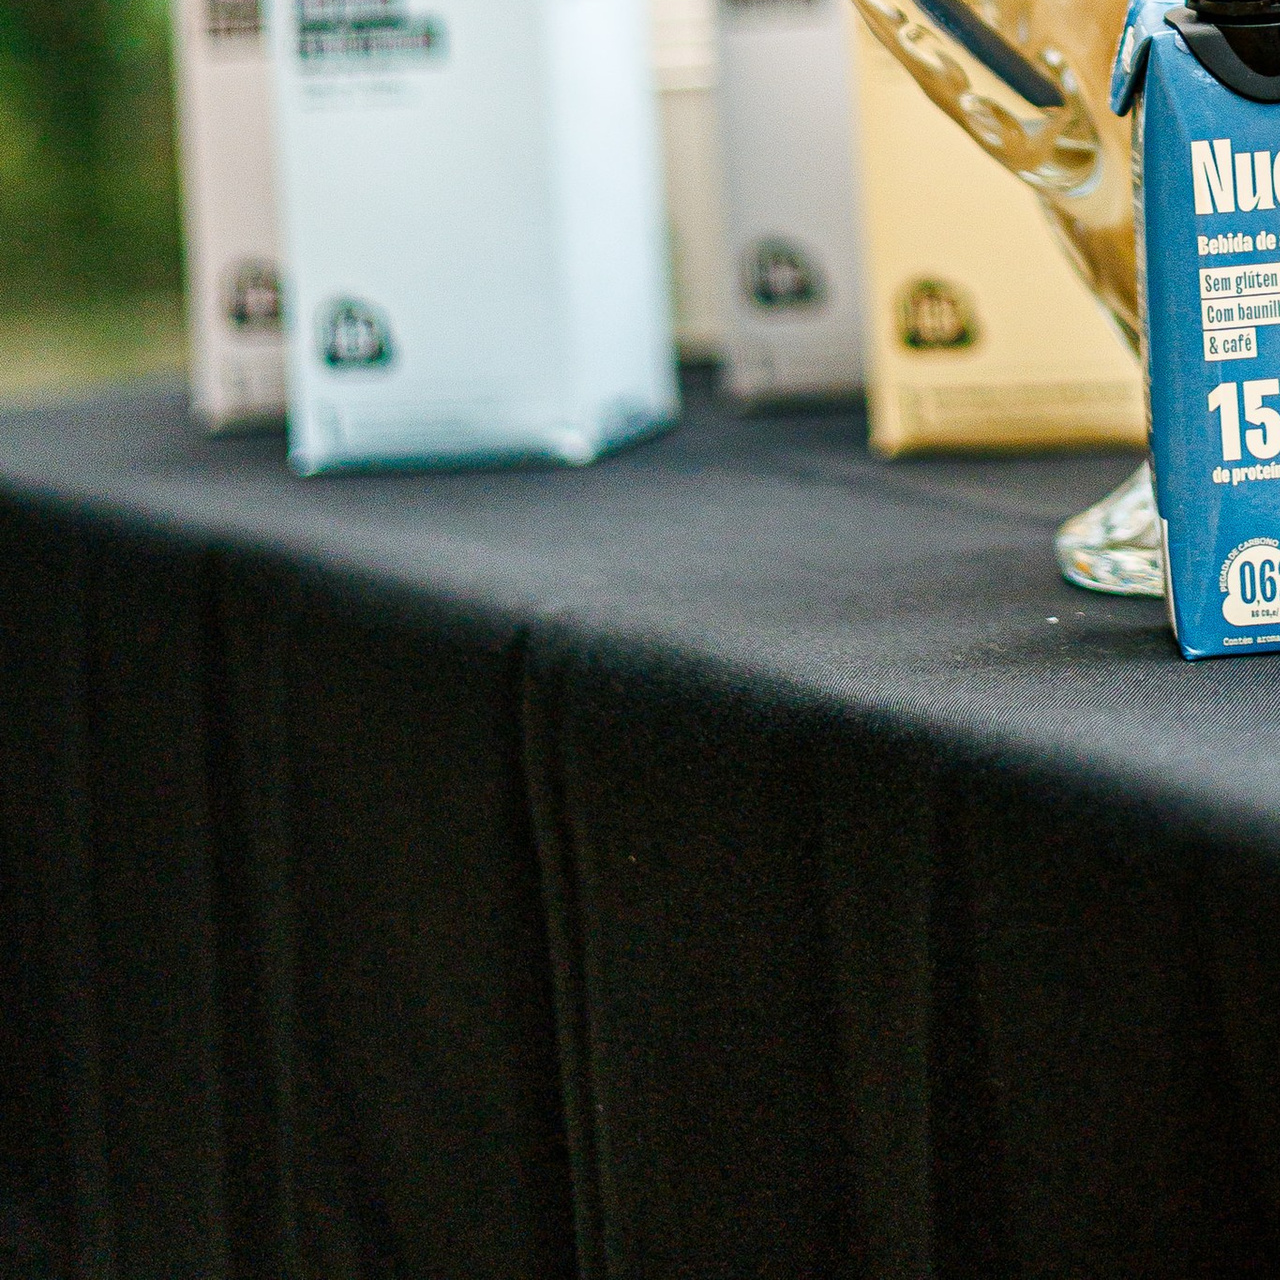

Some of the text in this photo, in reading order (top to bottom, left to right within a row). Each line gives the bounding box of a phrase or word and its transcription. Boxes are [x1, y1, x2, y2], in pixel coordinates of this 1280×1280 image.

[1197, 232, 1253, 256] Bebida
[1256, 230, 1277, 251] de
[1204, 270, 1278, 294] Sem glúten
[1207, 305, 1234, 323] Com
[1209, 333, 1252, 354] & café
[1212, 466, 1231, 484] de
